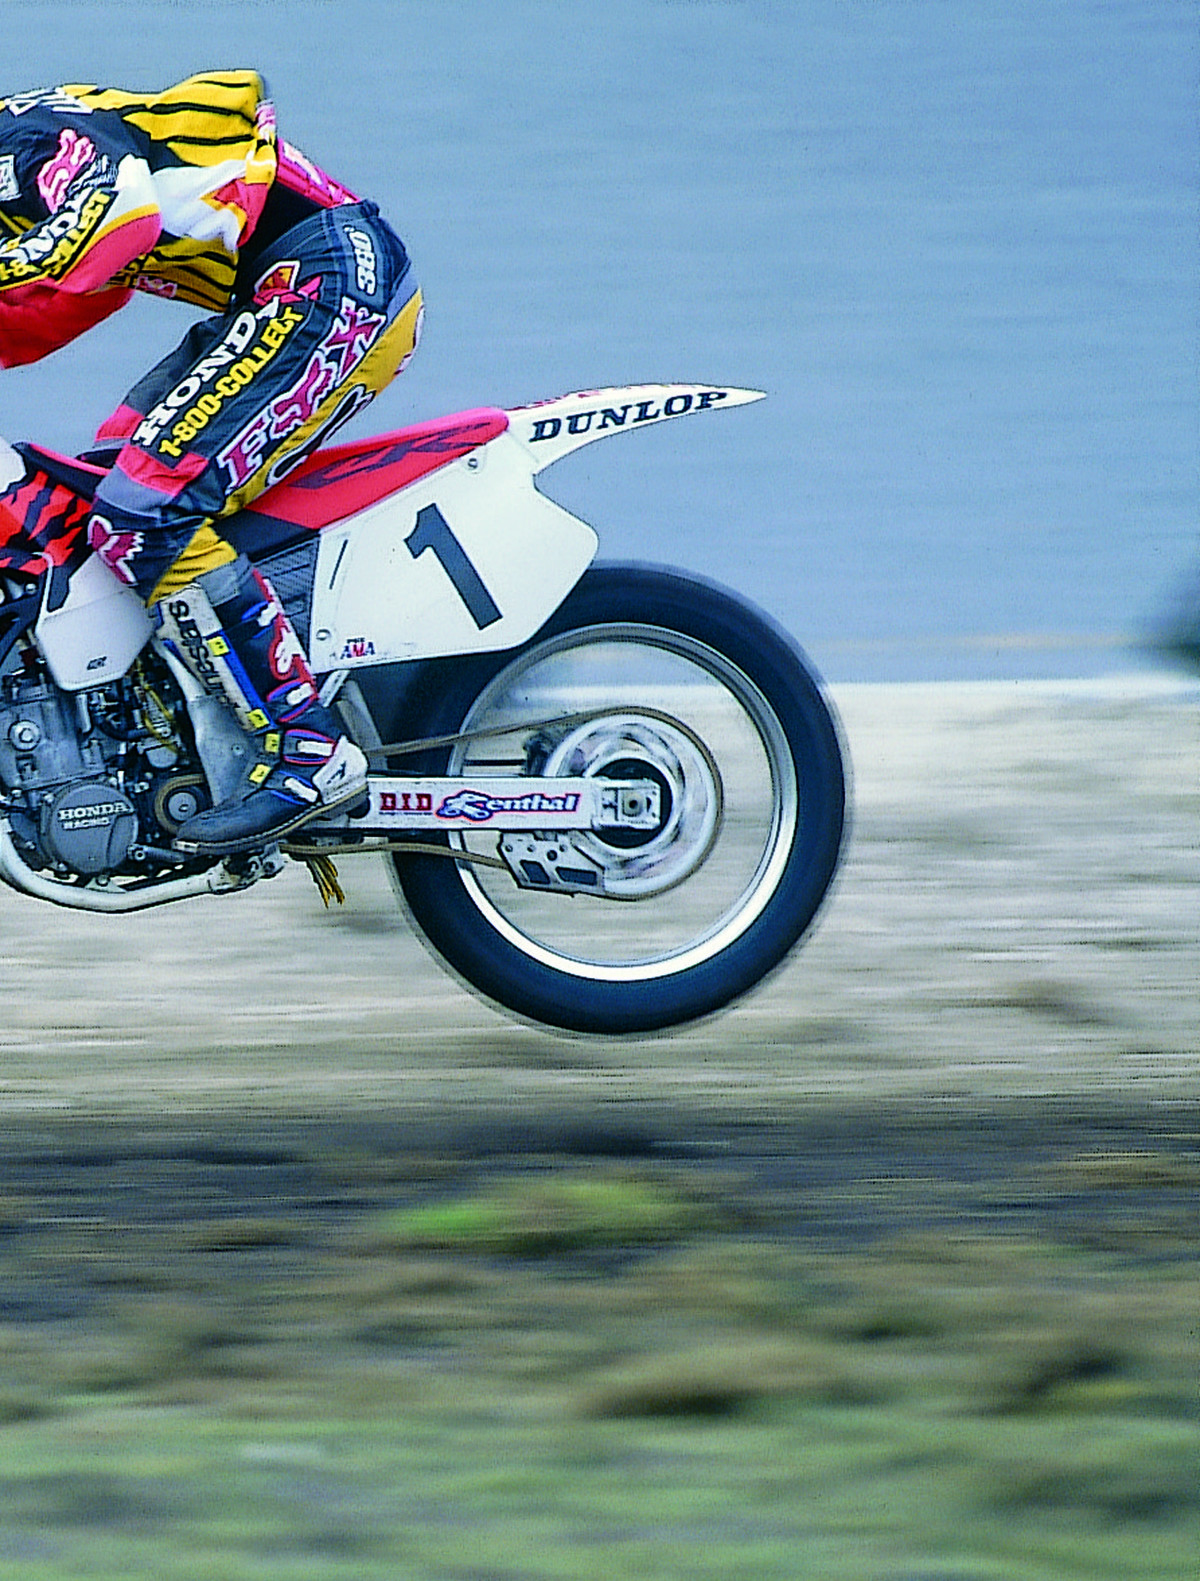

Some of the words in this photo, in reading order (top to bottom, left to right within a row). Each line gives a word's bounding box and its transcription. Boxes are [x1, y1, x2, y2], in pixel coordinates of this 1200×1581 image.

[158, 305, 305, 458] 1-800-COLLECT
[528, 391, 728, 443] DUNLOP
[402, 502, 504, 631] 1
[57, 801, 130, 821] HONDA
[435, 790, 581, 822] Renthal
